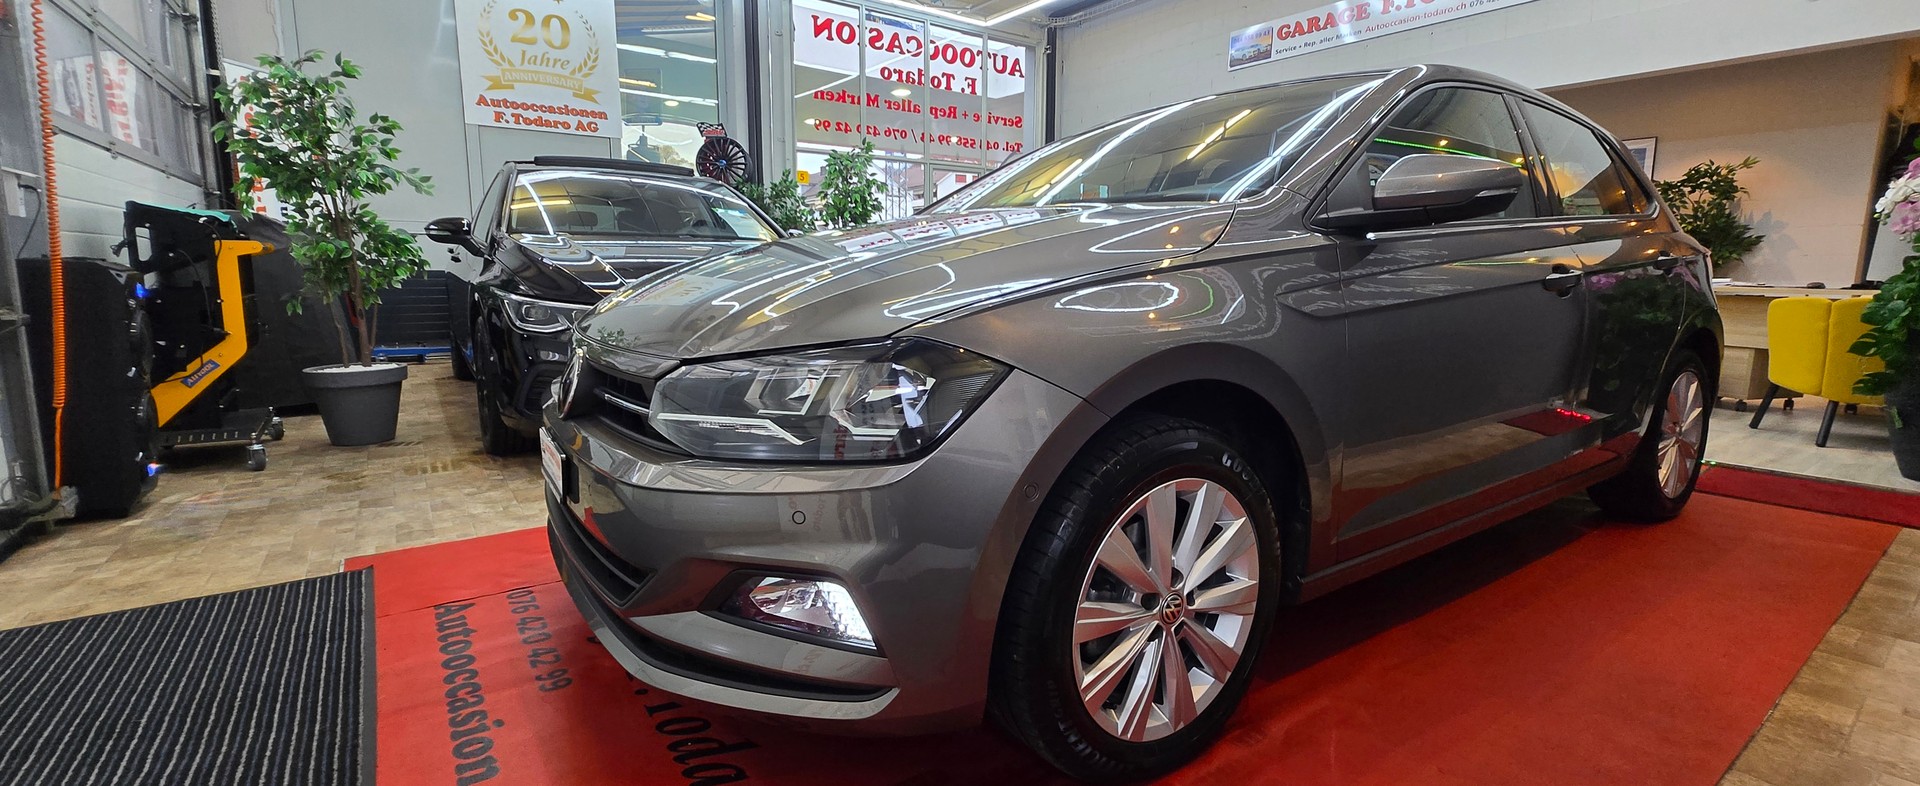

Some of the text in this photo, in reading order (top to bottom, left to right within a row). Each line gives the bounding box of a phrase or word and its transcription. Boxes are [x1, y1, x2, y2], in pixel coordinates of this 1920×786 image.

[508, 8, 571, 50] 20
[1275, 45, 1298, 56] Service
[1303, 40, 1318, 49] Rep.
[1319, 36, 1335, 44] aller
[1364, 2, 1467, 33] Autooccasion-todaro.ch
[1276, 2, 1371, 41] GARAGE
[519, 49, 571, 71] Jahre
[504, 71, 582, 90] ANNIVERSARY
[475, 93, 609, 121] Autooccasionen
[493, 110, 600, 133] F. Todaro AG
[506, 589, 573, 693] 076 420 42 99
